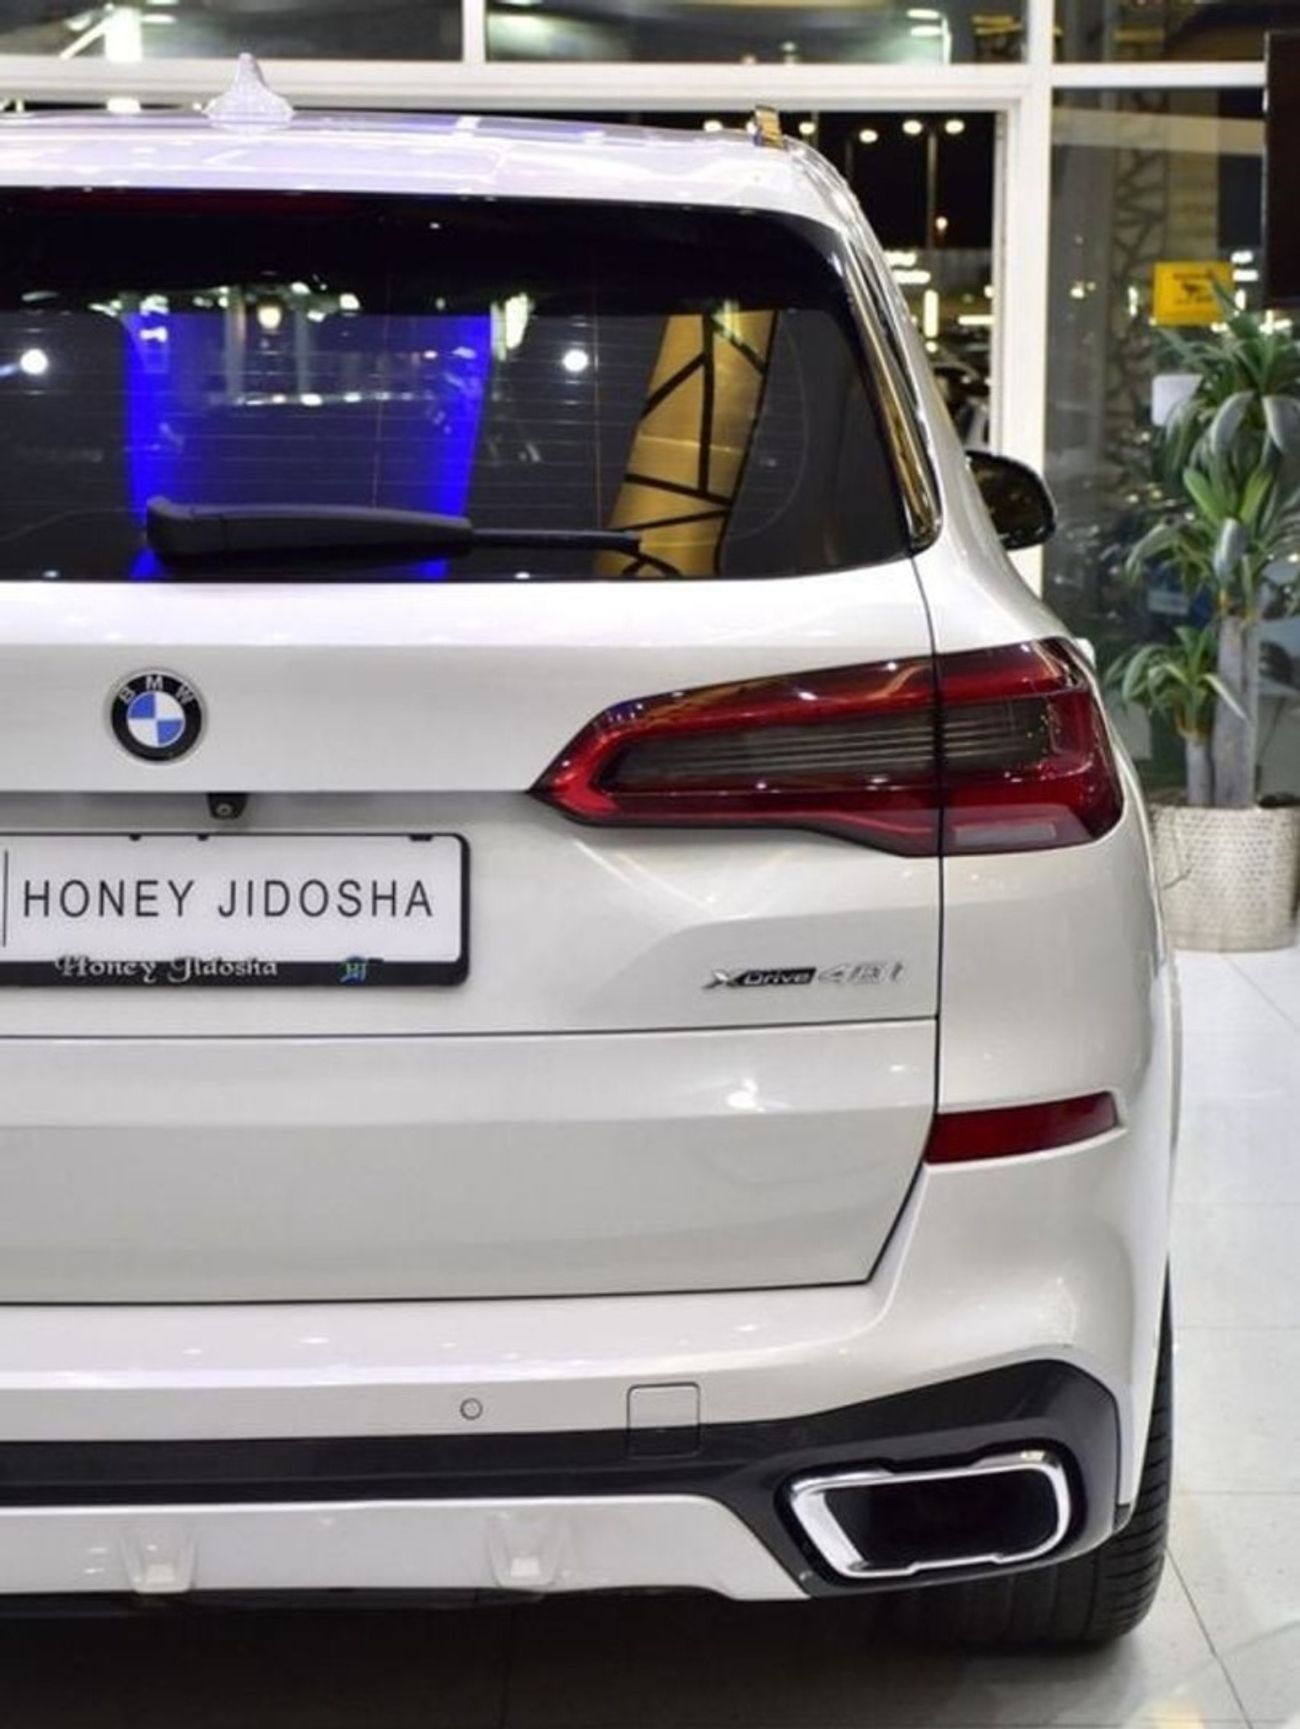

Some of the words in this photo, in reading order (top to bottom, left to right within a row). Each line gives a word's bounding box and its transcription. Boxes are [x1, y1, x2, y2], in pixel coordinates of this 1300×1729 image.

[117, 674, 196, 705] BMW
[23, 879, 195, 918] HONEY
[217, 879, 434, 918] JIDOSHA
[54, 955, 157, 984] Honey
